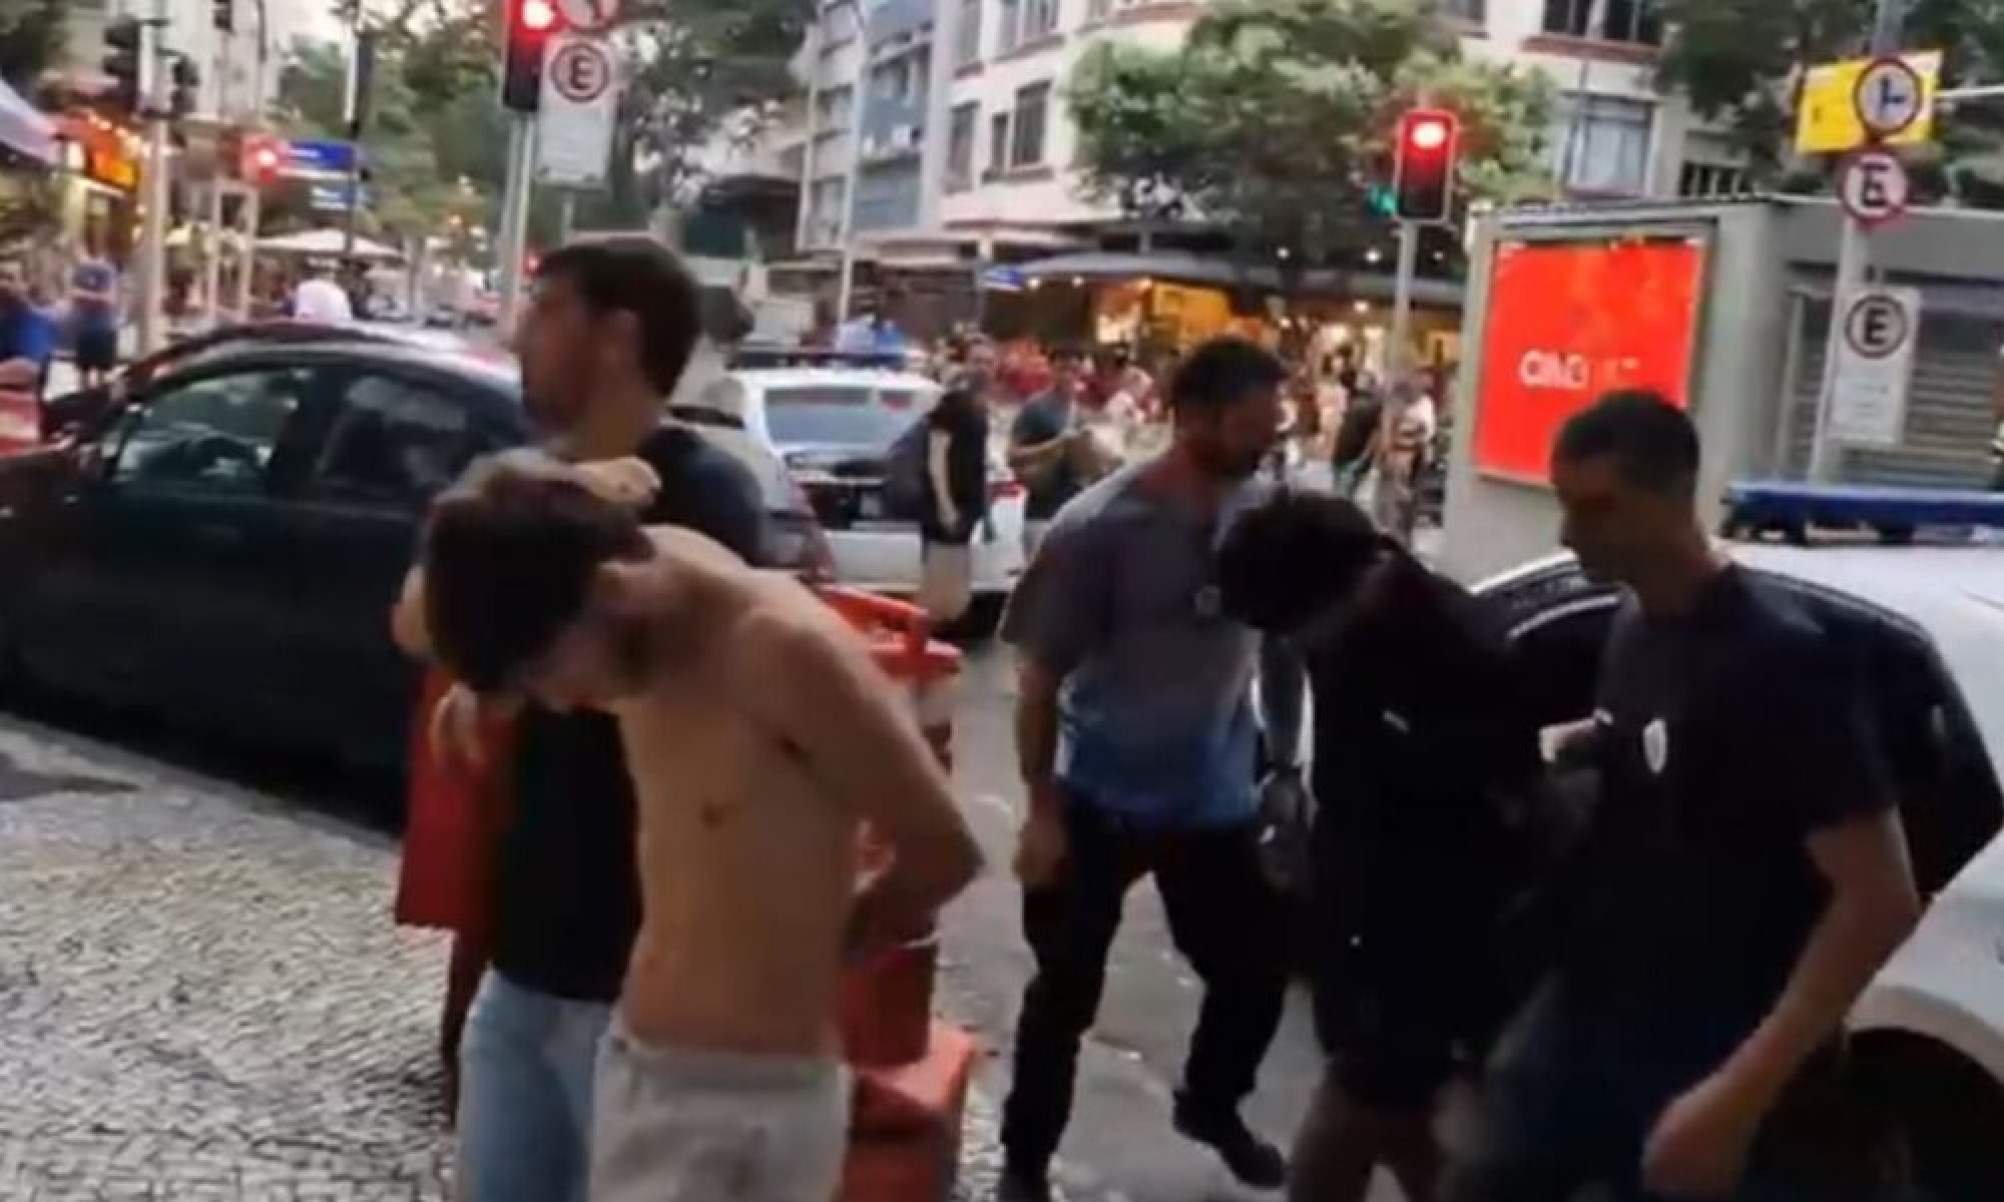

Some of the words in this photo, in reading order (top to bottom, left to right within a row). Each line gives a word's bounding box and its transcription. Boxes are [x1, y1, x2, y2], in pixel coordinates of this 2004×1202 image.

[571, 55, 594, 90] E
[1860, 162, 1889, 208] E
[1864, 308, 1889, 346] E
